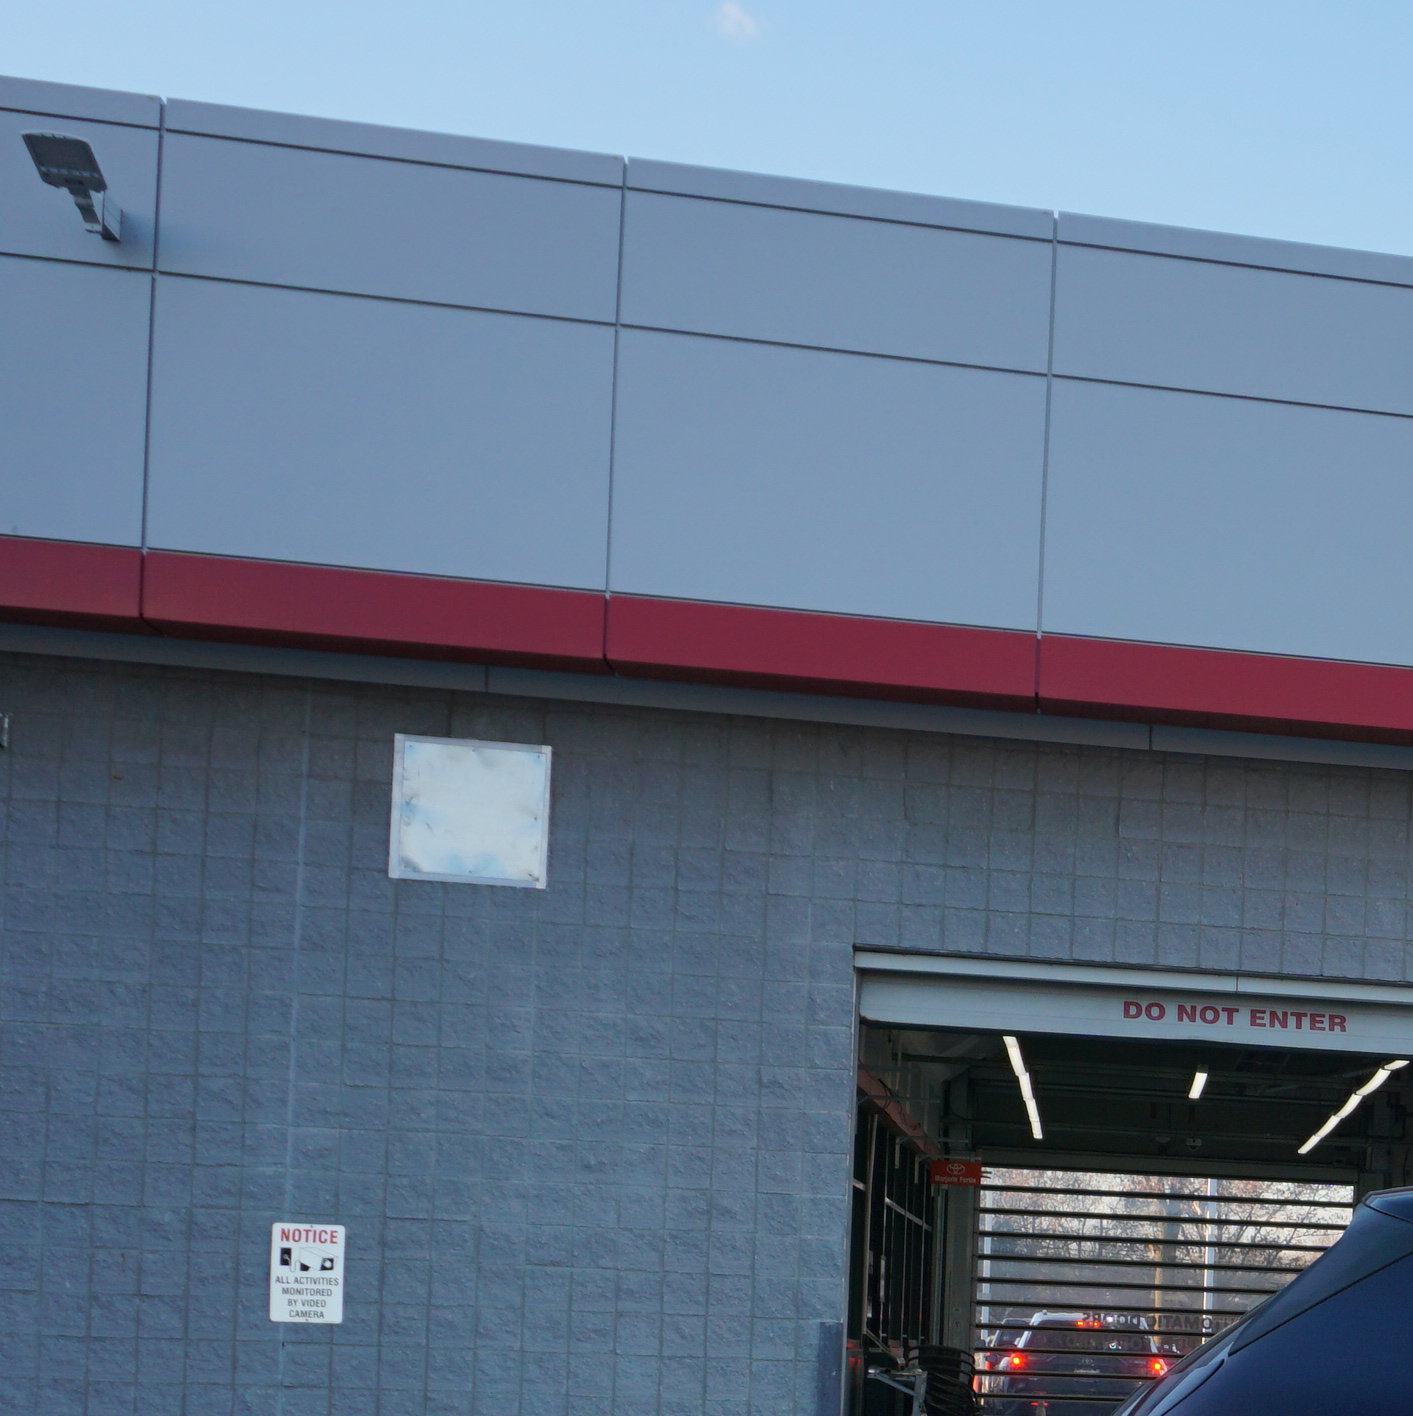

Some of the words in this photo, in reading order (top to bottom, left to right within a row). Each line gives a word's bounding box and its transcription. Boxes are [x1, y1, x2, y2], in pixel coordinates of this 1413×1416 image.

[1123, 1000, 1166, 1021] DO
[1177, 1004, 1239, 1026] NOT
[1249, 1008, 1347, 1032] ENTER
[280, 1228, 338, 1244] NOTICE
[275, 1276, 290, 1284] ALL
[293, 1276, 339, 1286] ACTIVITIES
[281, 1287, 333, 1297] MONITORED
[287, 1298, 298, 1307] BY
[301, 1299, 327, 1307] VIDEO
[289, 1310, 325, 1318] CAMERA
